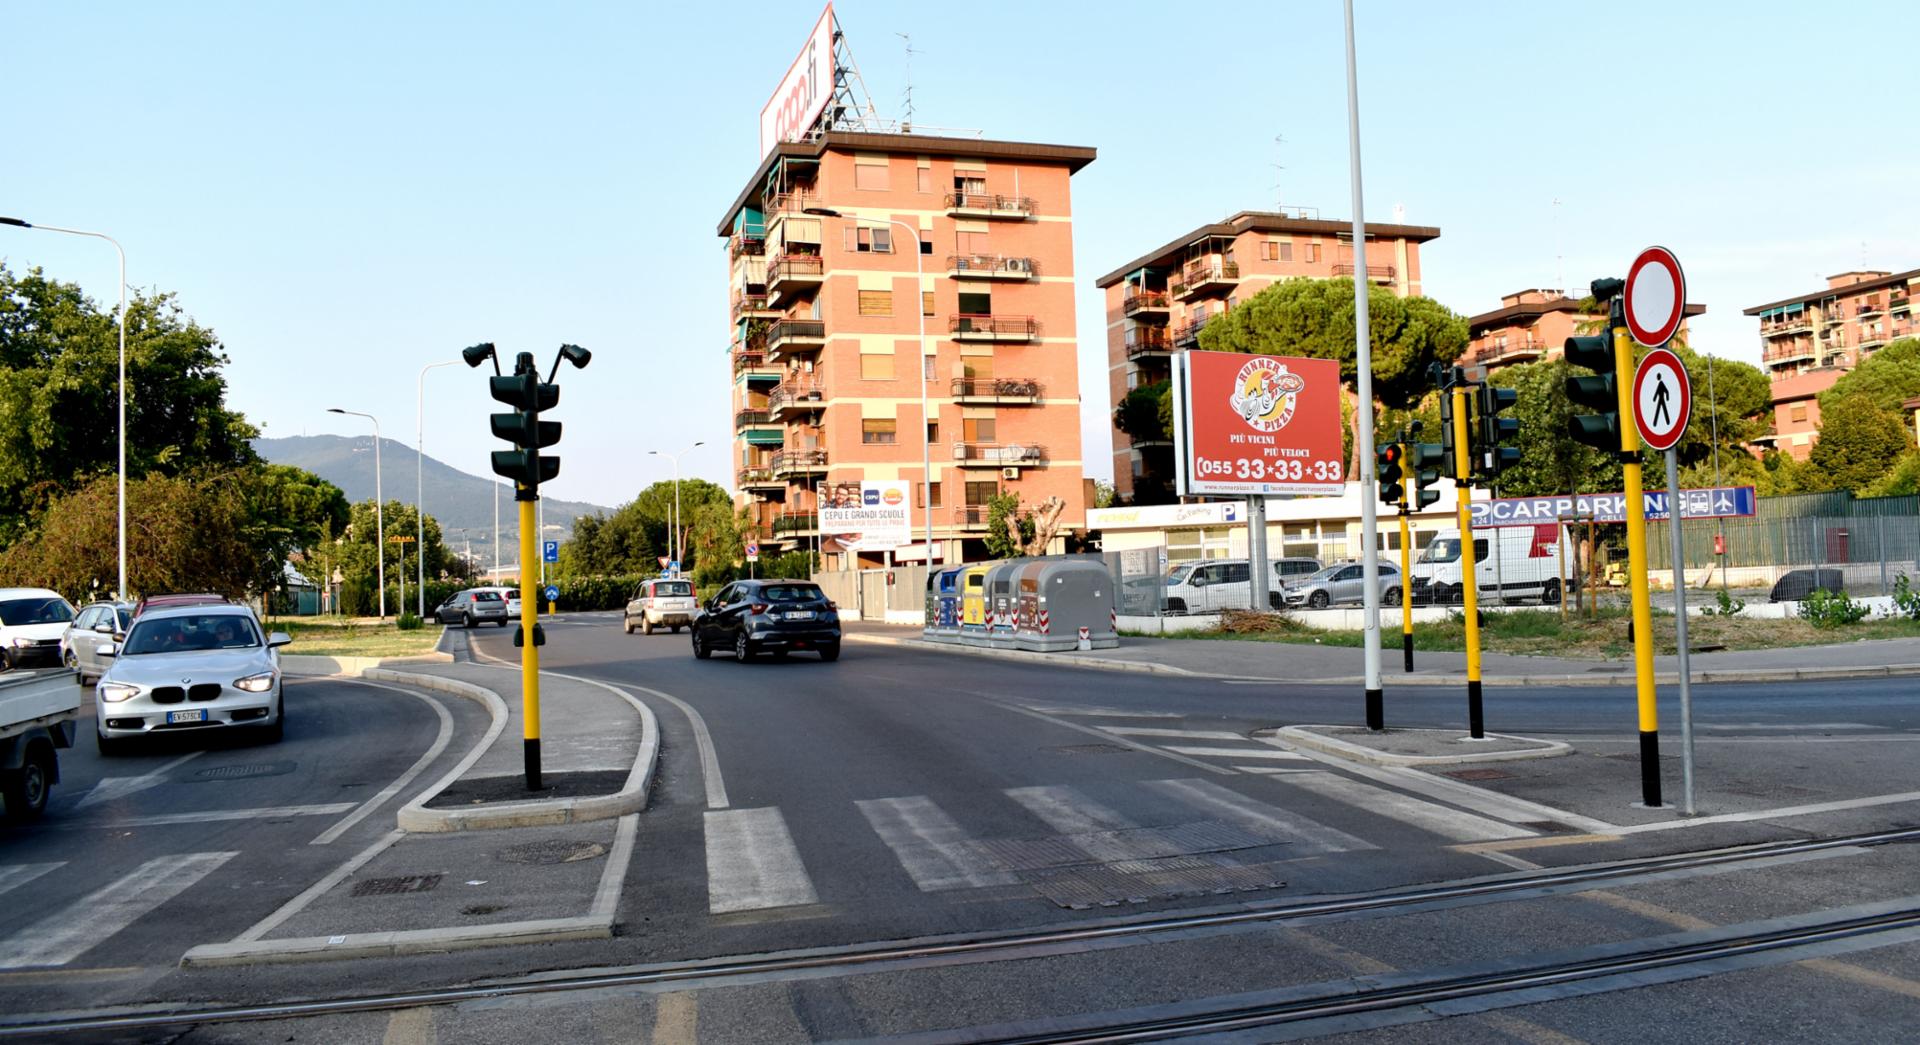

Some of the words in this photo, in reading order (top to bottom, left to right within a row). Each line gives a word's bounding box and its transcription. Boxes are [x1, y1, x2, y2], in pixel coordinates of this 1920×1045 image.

[1238, 359, 1281, 382] RUNNER
[1264, 408, 1293, 431] PIZZA
[1247, 434, 1276, 445] VICINI
[1280, 448, 1310, 458] VELOCI
[824, 510, 843, 520] CEPU
[845, 510, 849, 520] E
[851, 510, 877, 520] GRANDI
[878, 509, 905, 519] SCUOLE
[546, 543, 556, 554] P
